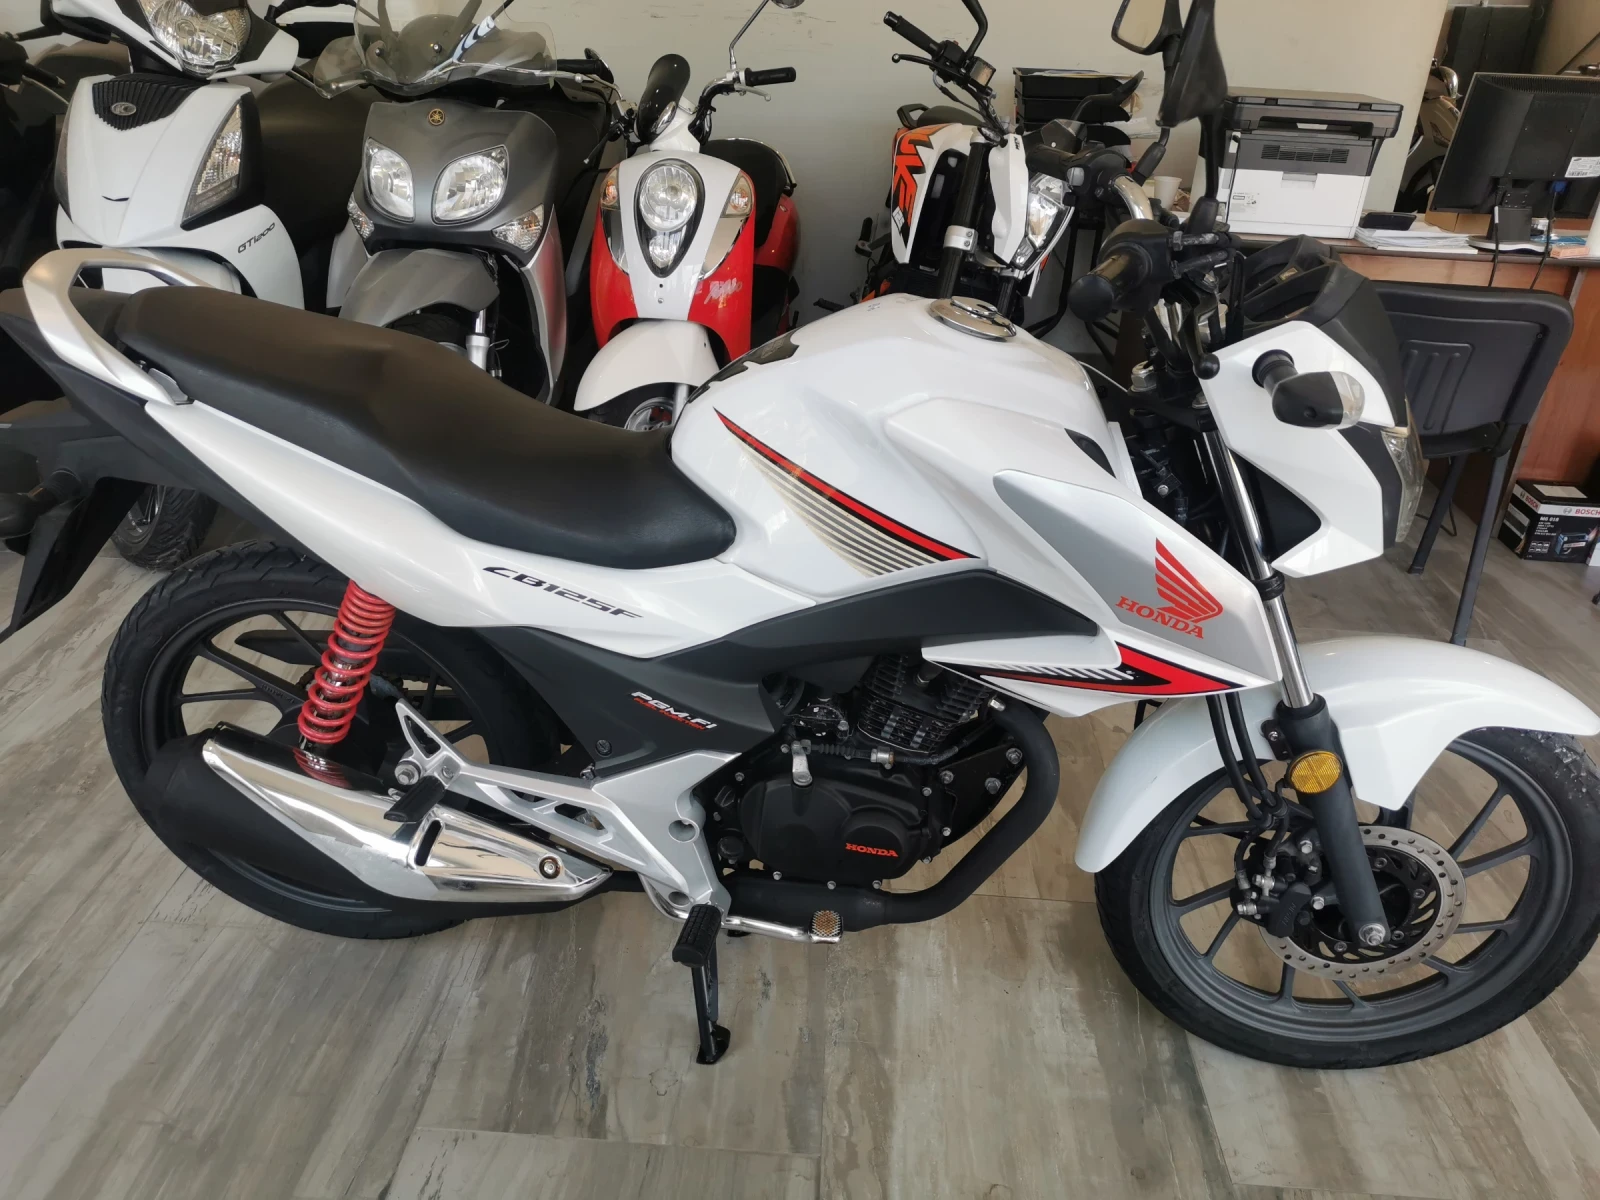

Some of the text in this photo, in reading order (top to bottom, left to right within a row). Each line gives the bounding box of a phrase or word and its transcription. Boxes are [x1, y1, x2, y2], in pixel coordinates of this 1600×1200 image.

[1575, 508, 1600, 517] BOSCH
[482, 566, 644, 619] CB125F
[1115, 595, 1204, 640] HONDA
[845, 842, 899, 858] HONDA
